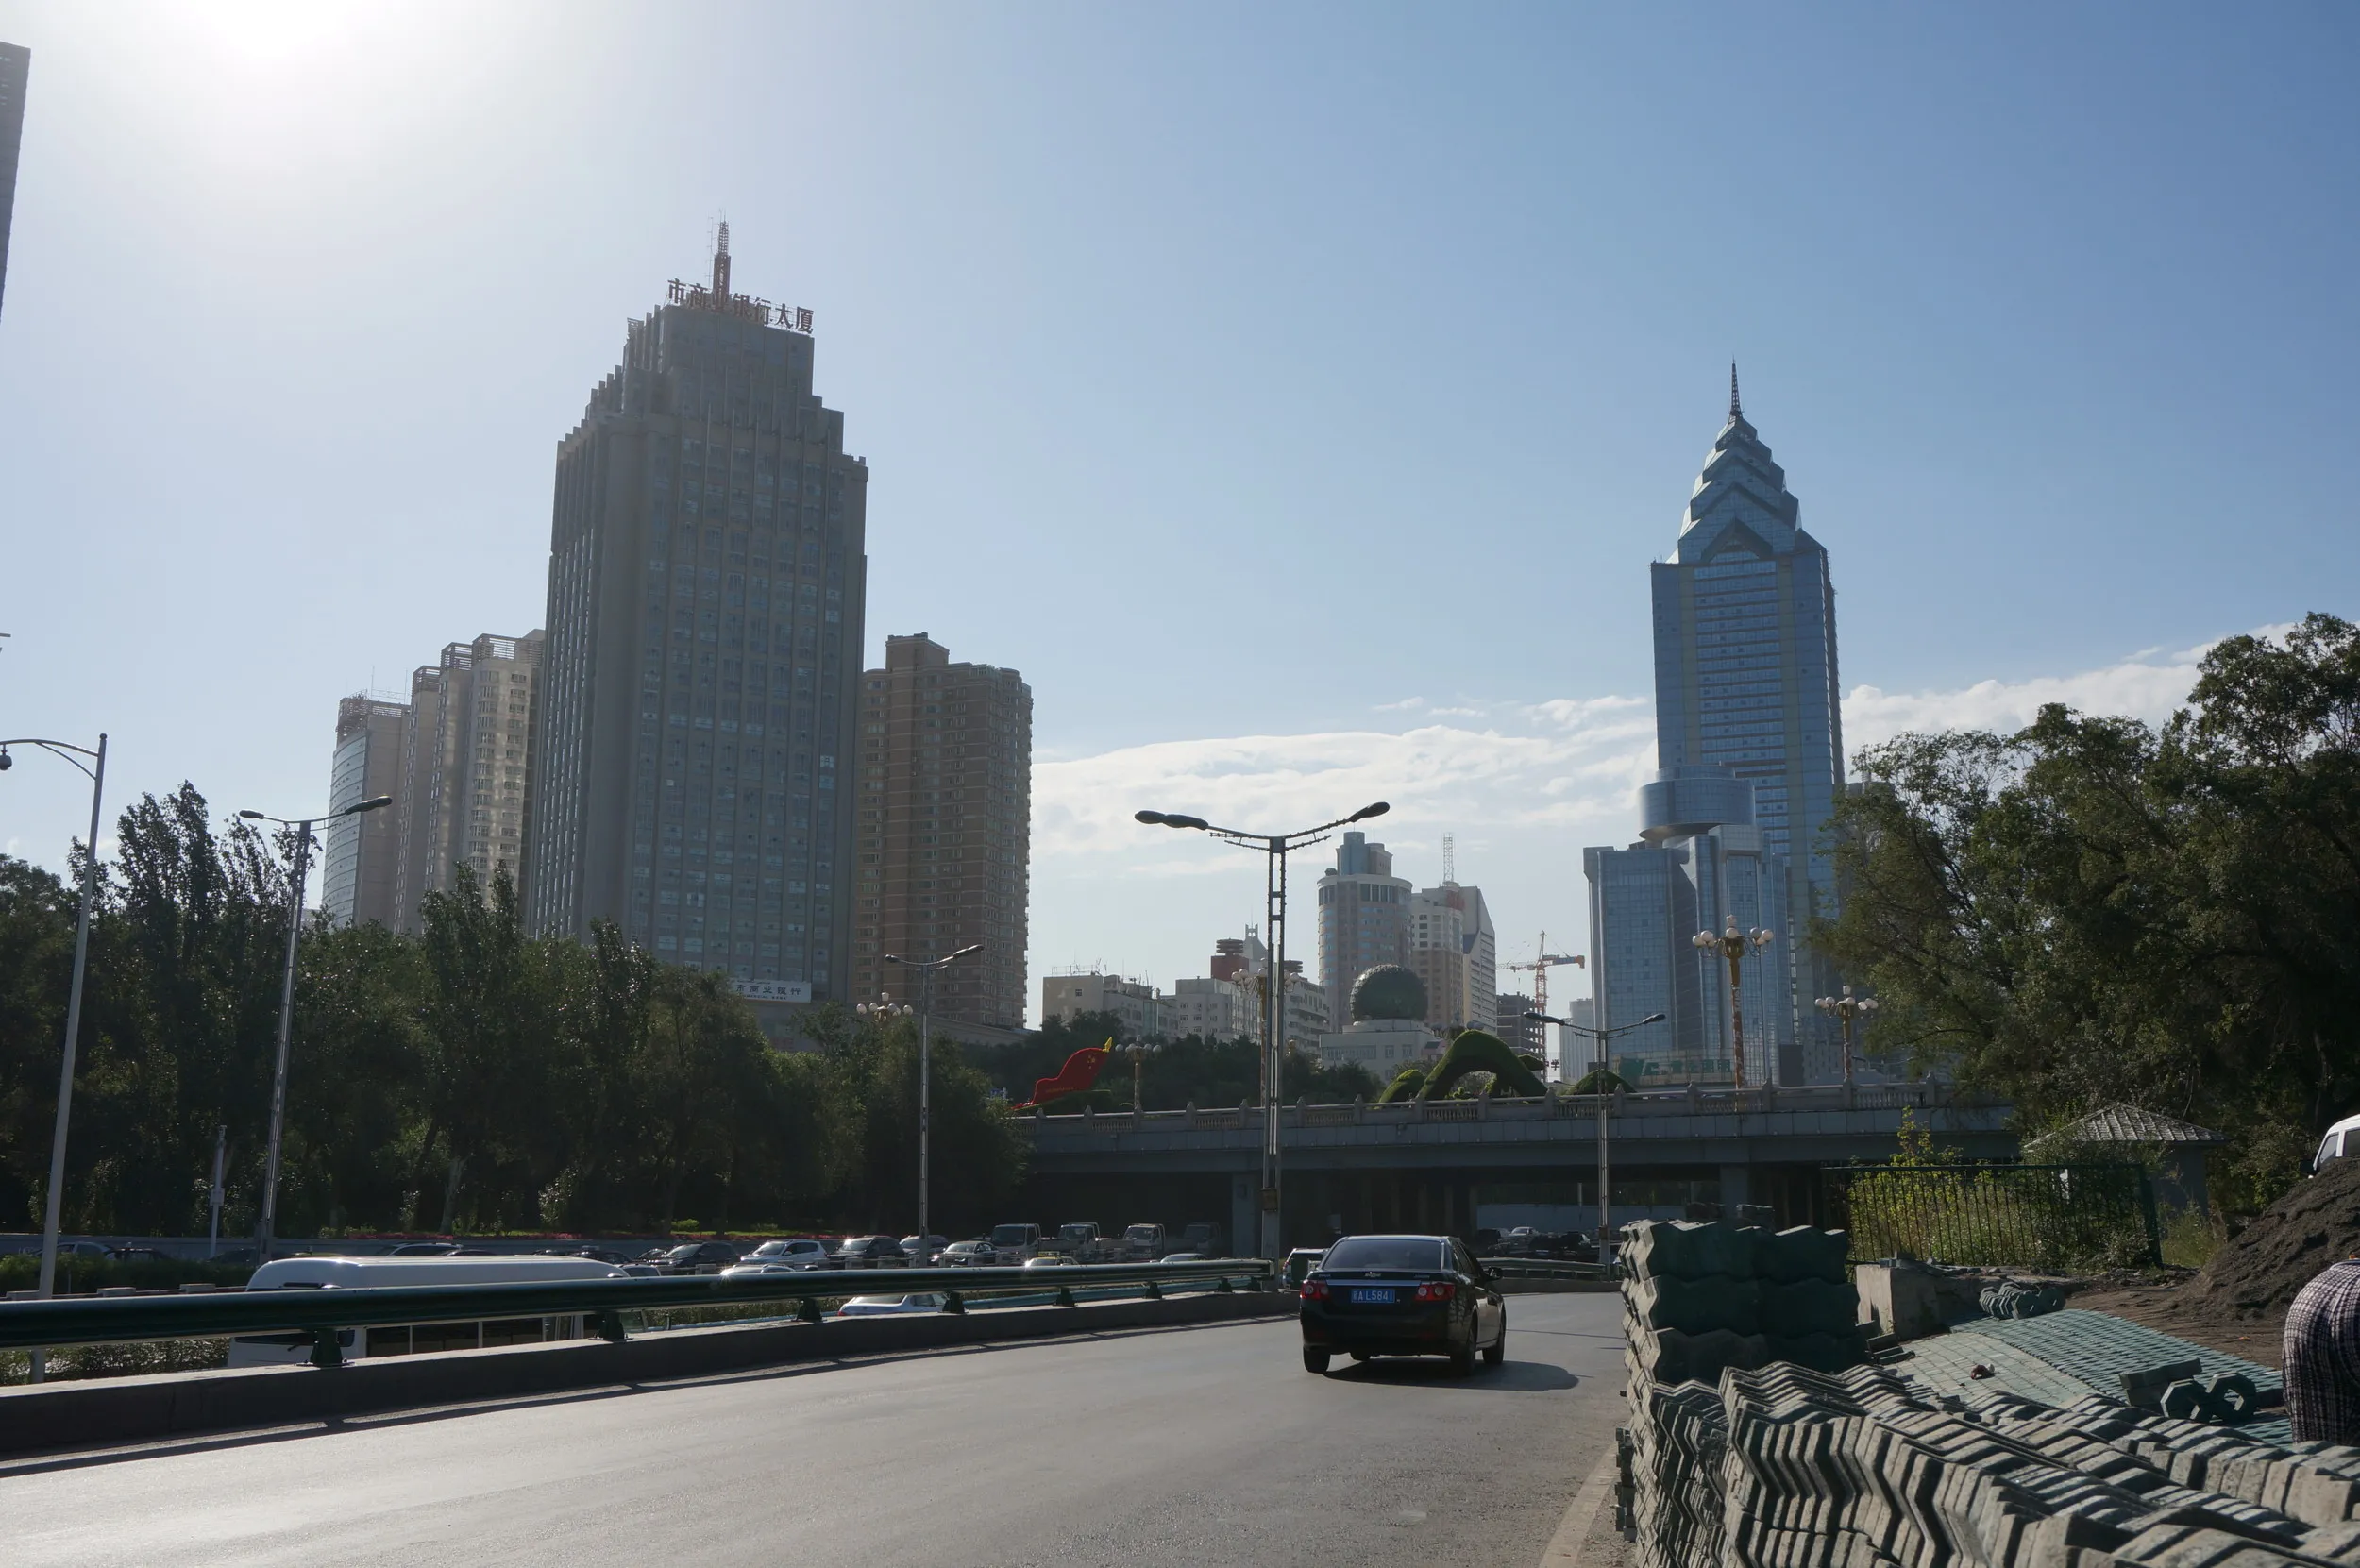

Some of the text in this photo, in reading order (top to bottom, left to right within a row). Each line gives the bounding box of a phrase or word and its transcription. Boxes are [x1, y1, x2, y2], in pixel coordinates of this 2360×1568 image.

[667, 278, 814, 334] 市商业银行大厦
